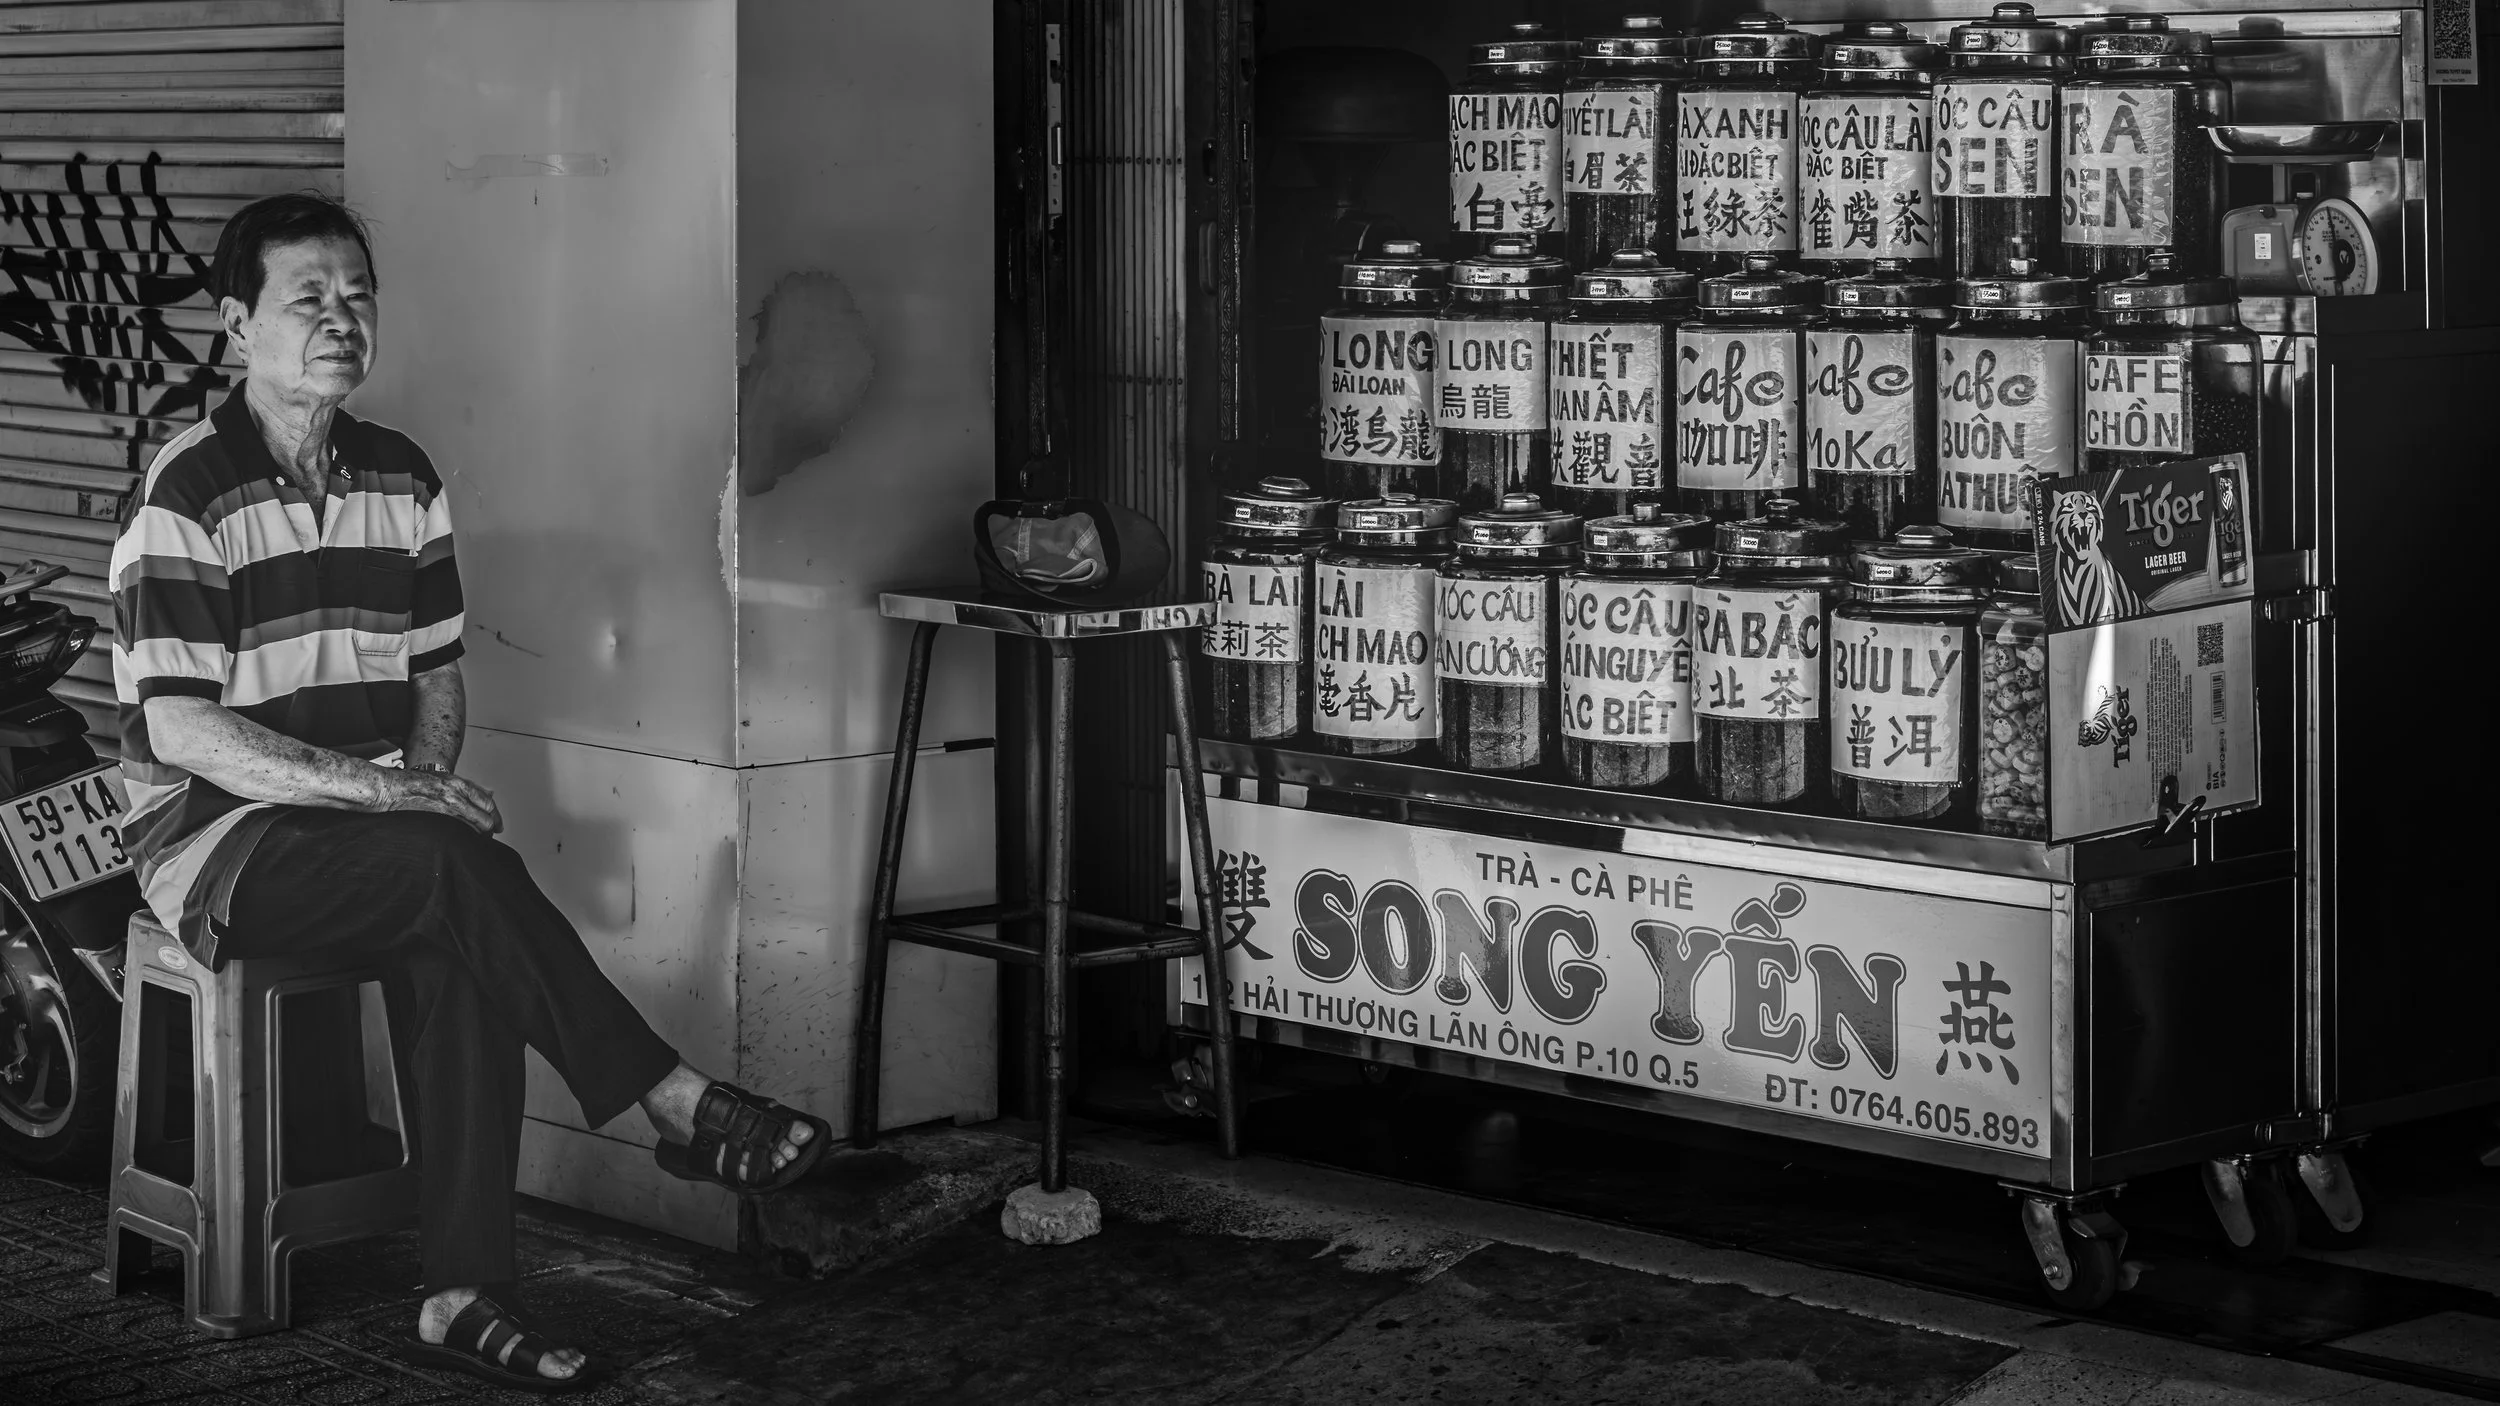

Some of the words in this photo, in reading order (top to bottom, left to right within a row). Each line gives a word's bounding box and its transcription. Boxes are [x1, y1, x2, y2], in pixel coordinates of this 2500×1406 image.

[1497, 96, 1560, 130] MAO
[1607, 96, 1652, 138] LÀI
[1825, 104, 1879, 150] CÂU
[1884, 102, 1932, 152] LÀI
[1933, 85, 1968, 130] ÓC
[1978, 88, 2050, 131] CÂU
[1483, 132, 1545, 178] BIỆT
[1807, 149, 1834, 182] ĐẶC
[1841, 150, 1888, 184] BIỆT
[1935, 137, 2038, 194] SEN
[1450, 181, 1554, 231] 白毫
[1800, 187, 1929, 249] 雀嘴茶
[2062, 167, 2143, 229] SEN
[1333, 330, 1433, 372] LONG
[1448, 339, 1533, 372] LONG
[2087, 356, 2180, 393] CAFE
[1333, 370, 1354, 393] ĐÀI
[1359, 376, 1405, 396] LOAN
[1594, 381, 1655, 423] ÂM
[1941, 412, 2025, 459] BUÔN
[2087, 398, 2179, 447] CHỒN
[1680, 418, 1787, 479] 咖啡
[2120, 481, 2204, 547] Tiger
[2145, 554, 2167, 569] LAGER
[2169, 551, 2187, 565] BEER
[1249, 568, 1299, 606] LÀI
[1319, 569, 1364, 618] LÀI
[1481, 584, 1534, 623] CÂU
[1561, 580, 1598, 630] ÓC
[1605, 588, 1688, 637] CÂU
[1356, 628, 1428, 665] MAO
[1740, 593, 1820, 659] BẮC
[1584, 638, 1691, 683] NGUYÊ
[1847, 703, 1941, 768] 普洱
[2111, 685, 2137, 768] Tiger
[2212, 771, 2220, 789] BIA
[16, 775, 122, 842] 59-KA
[1215, 849, 1273, 960] 雙
[1477, 852, 1538, 889] TRÀ
[1571, 863, 1615, 899] CÀ
[1629, 874, 1693, 911] PHÊ
[1293, 868, 1606, 1026] SONG
[1631, 882, 1907, 1080] YẾN
[1244, 975, 1288, 1014] HẢI
[1298, 989, 1418, 1037] THƯỢNG
[1430, 1012, 1487, 1050] LÃN
[1498, 1021, 1564, 1064] ÔNG
[1577, 1042, 1638, 1078] P.10
[1649, 1054, 1699, 1088] Q.5
[1936, 961, 2019, 1085] 燕
[1765, 1073, 1817, 1109] ĐT:
[1831, 1085, 2039, 1148] 0764.605.893
